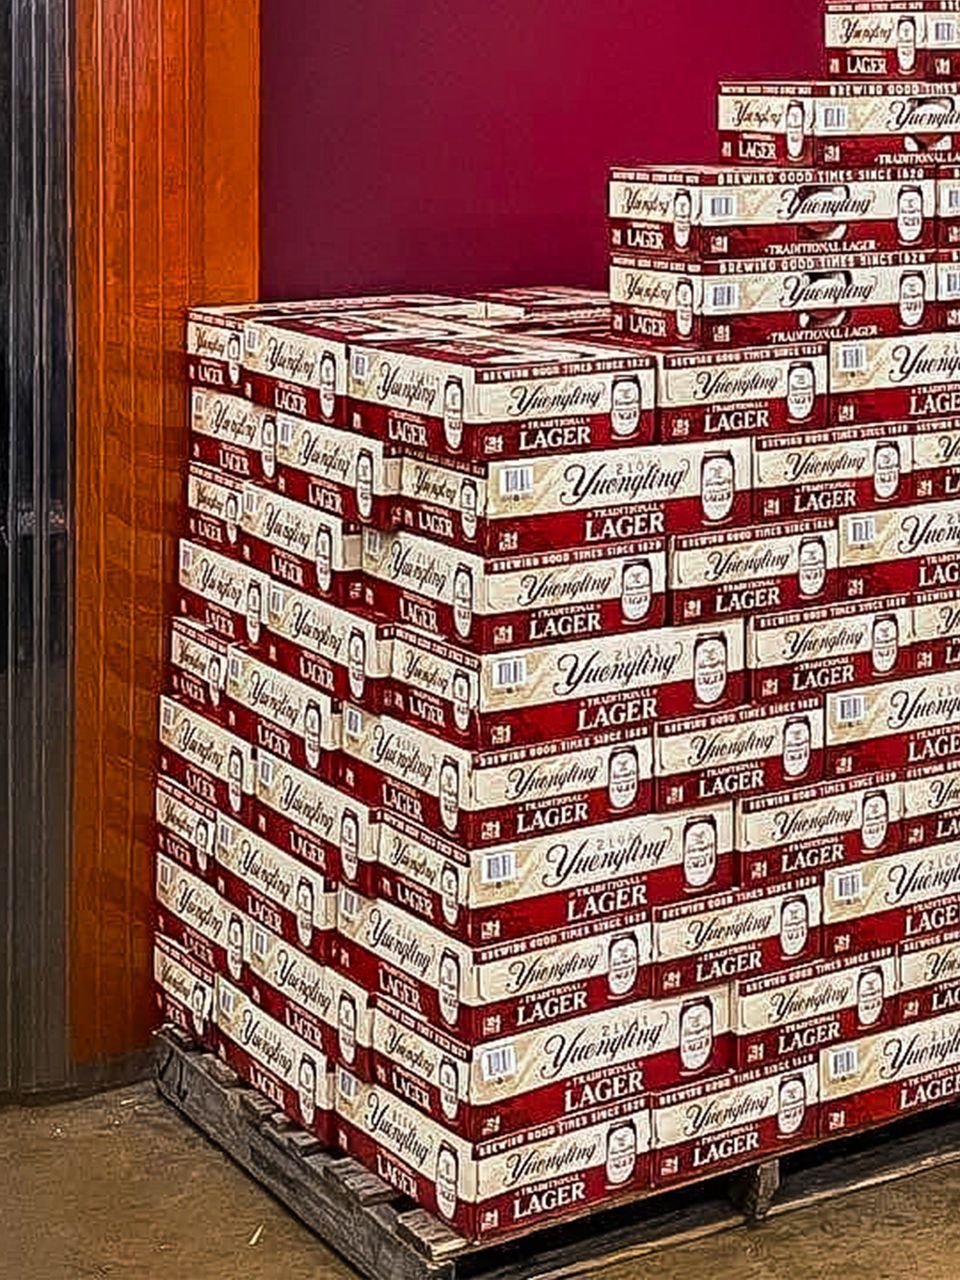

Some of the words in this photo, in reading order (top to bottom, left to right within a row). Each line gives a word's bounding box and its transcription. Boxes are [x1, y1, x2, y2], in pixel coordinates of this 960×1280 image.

[704, 410, 769, 433] LAGER
[520, 426, 591, 450] LAGER
[794, 490, 856, 512] LAGER
[585, 513, 665, 541] LAGER
[716, 587, 780, 613] LAGER
[530, 614, 600, 641] LAGER
[792, 665, 855, 692] LAGER
[577, 698, 658, 731] LAGER
[700, 769, 764, 797] LAGER
[516, 803, 589, 834] LAGER
[782, 844, 845, 872] LAGER
[566, 883, 647, 921] LAGER
[696, 951, 762, 981] LAGER
[516, 991, 587, 1026] LAGER
[778, 1022, 840, 1053] LAGER
[564, 1072, 644, 1112] LAGER
[693, 1132, 759, 1166] LAGER
[513, 1182, 586, 1218] LAGER
